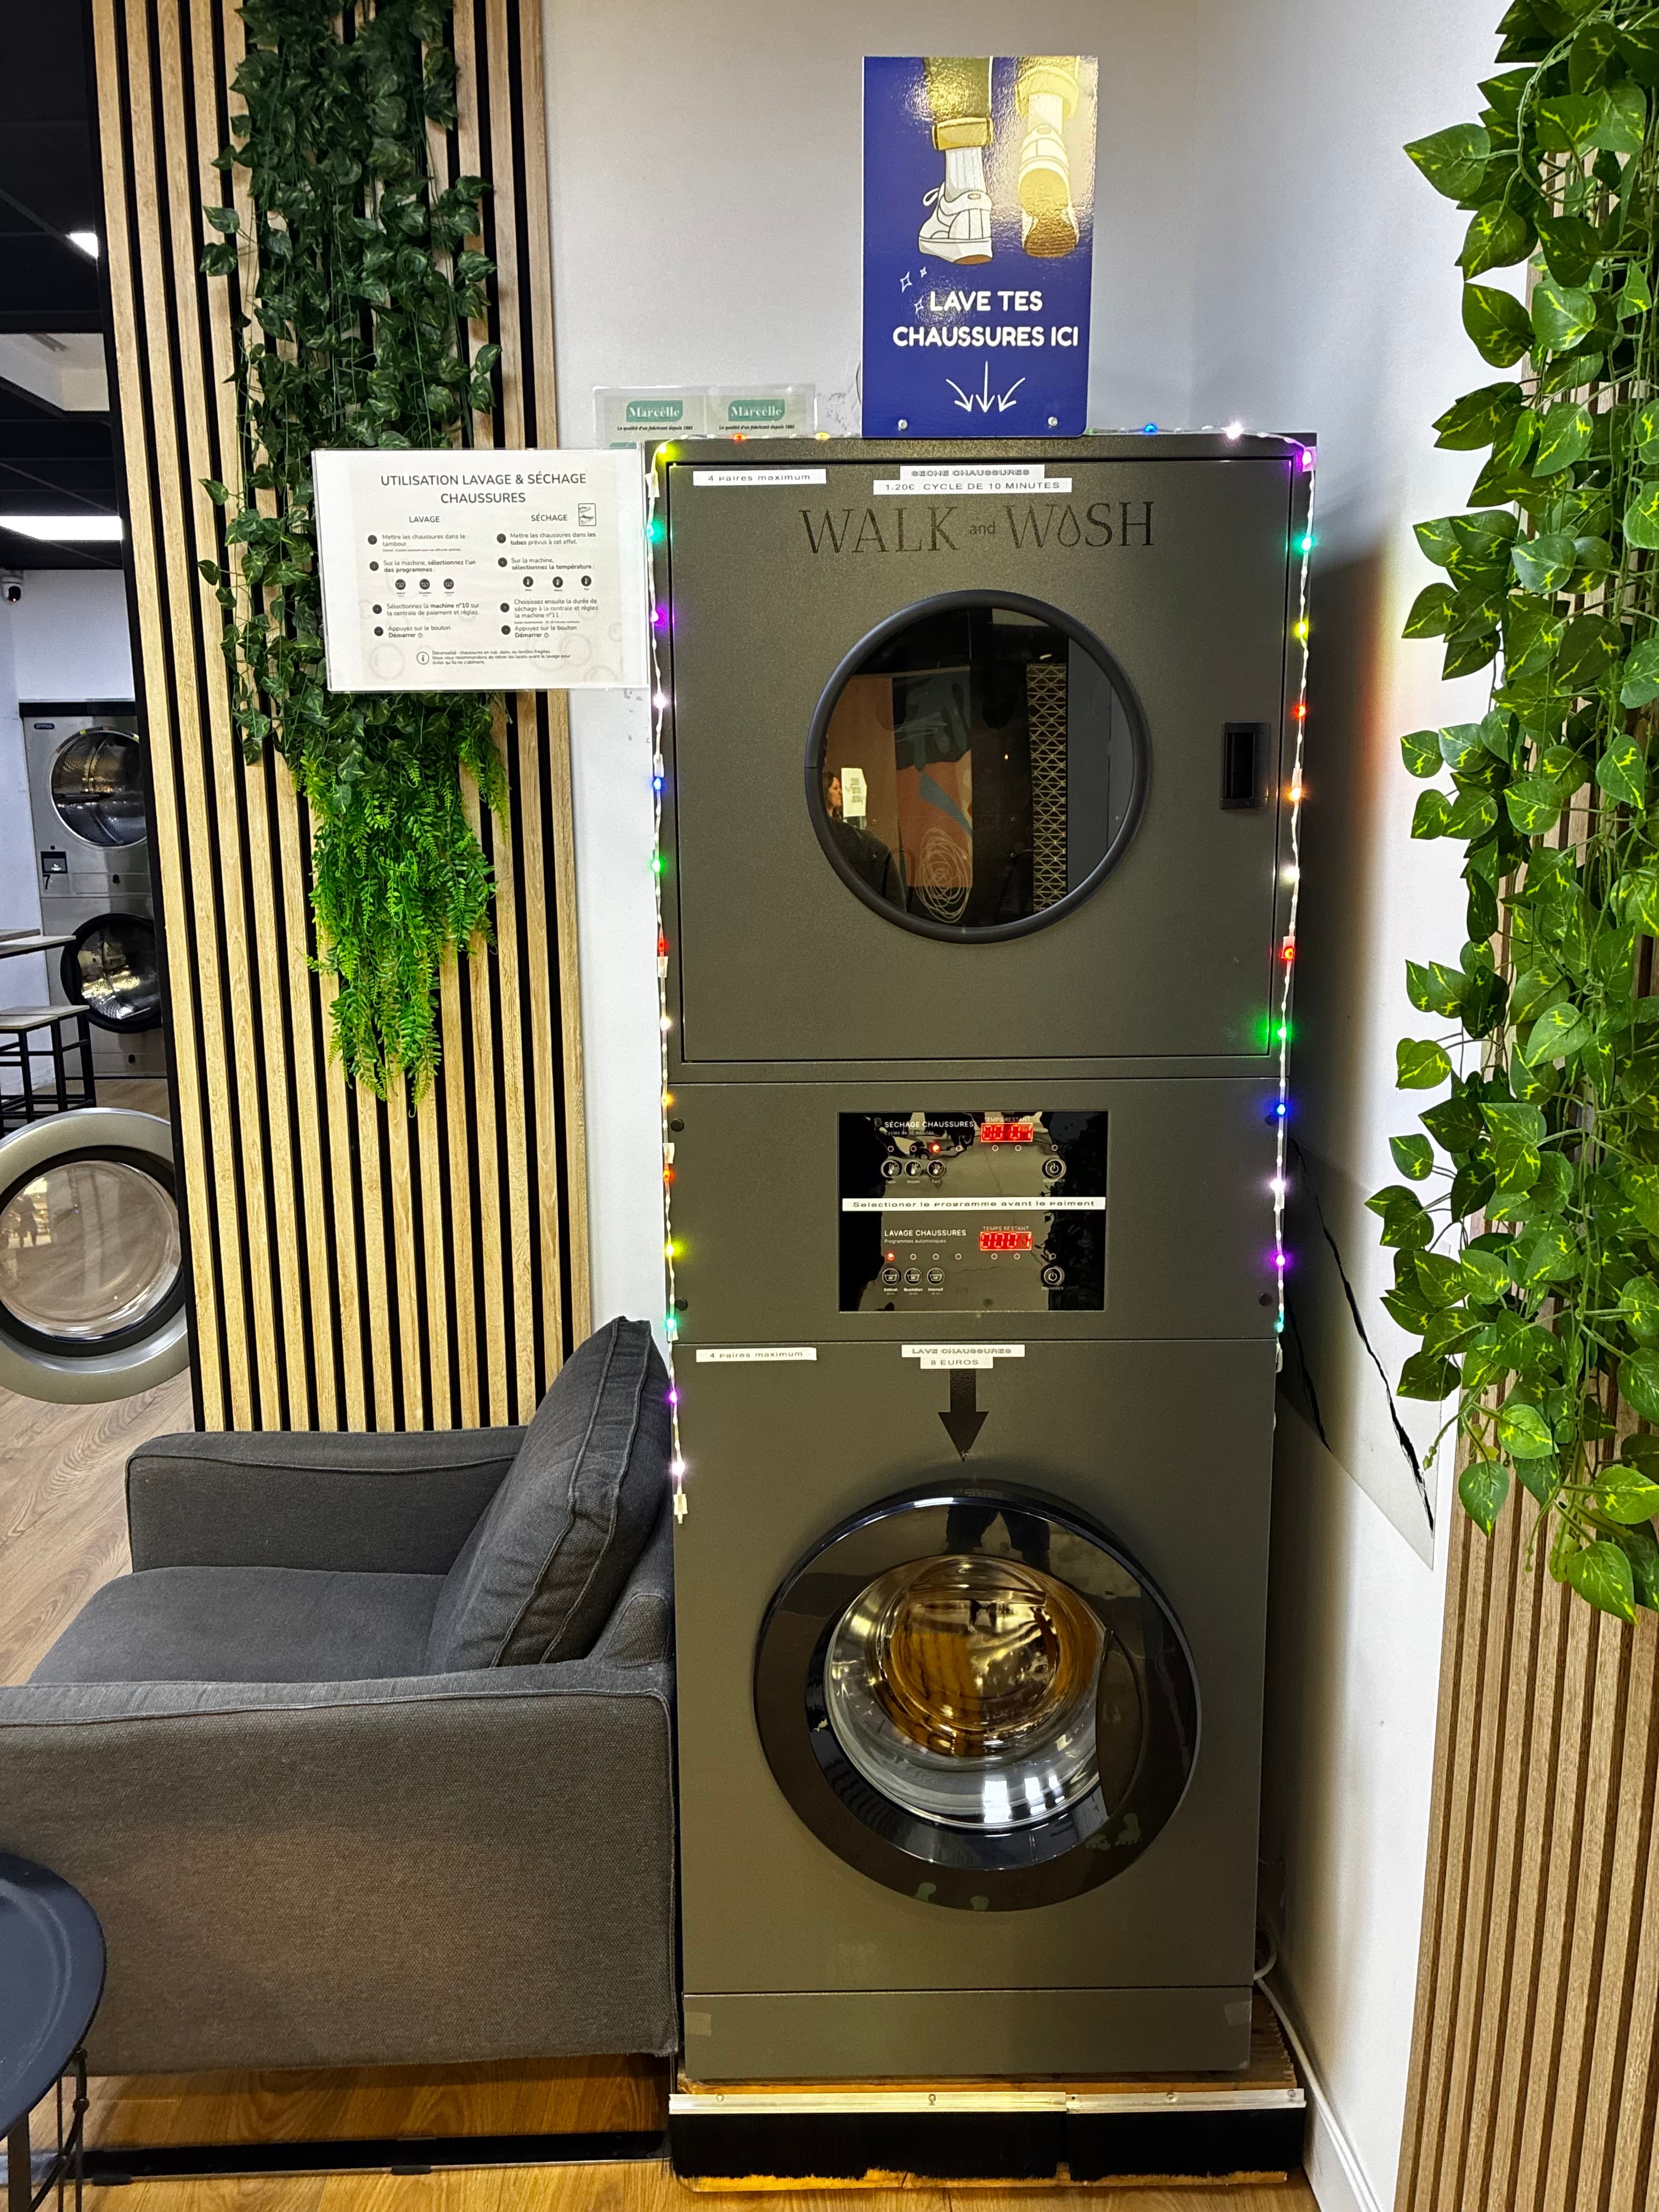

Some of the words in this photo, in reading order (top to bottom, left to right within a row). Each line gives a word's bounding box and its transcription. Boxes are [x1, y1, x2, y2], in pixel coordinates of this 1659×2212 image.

[930, 291, 991, 312] LAVE
[997, 291, 1042, 311] TES
[893, 326, 1044, 347] CHAUSSURES
[1051, 326, 1078, 346] ICI
[629, 407, 680, 417] Marcelle
[731, 406, 782, 416] Marcelle
[381, 475, 459, 486] UTILISATION
[462, 474, 512, 485] LAVAGE
[516, 474, 524, 484] &
[527, 471, 586, 484] SÉCHAGE
[441, 493, 526, 504] CHAUSSURES
[531, 514, 568, 522] SÉCHAGE
[798, 506, 958, 554] WALK
[969, 521, 996, 535] and
[43, 874, 50, 890] 7
